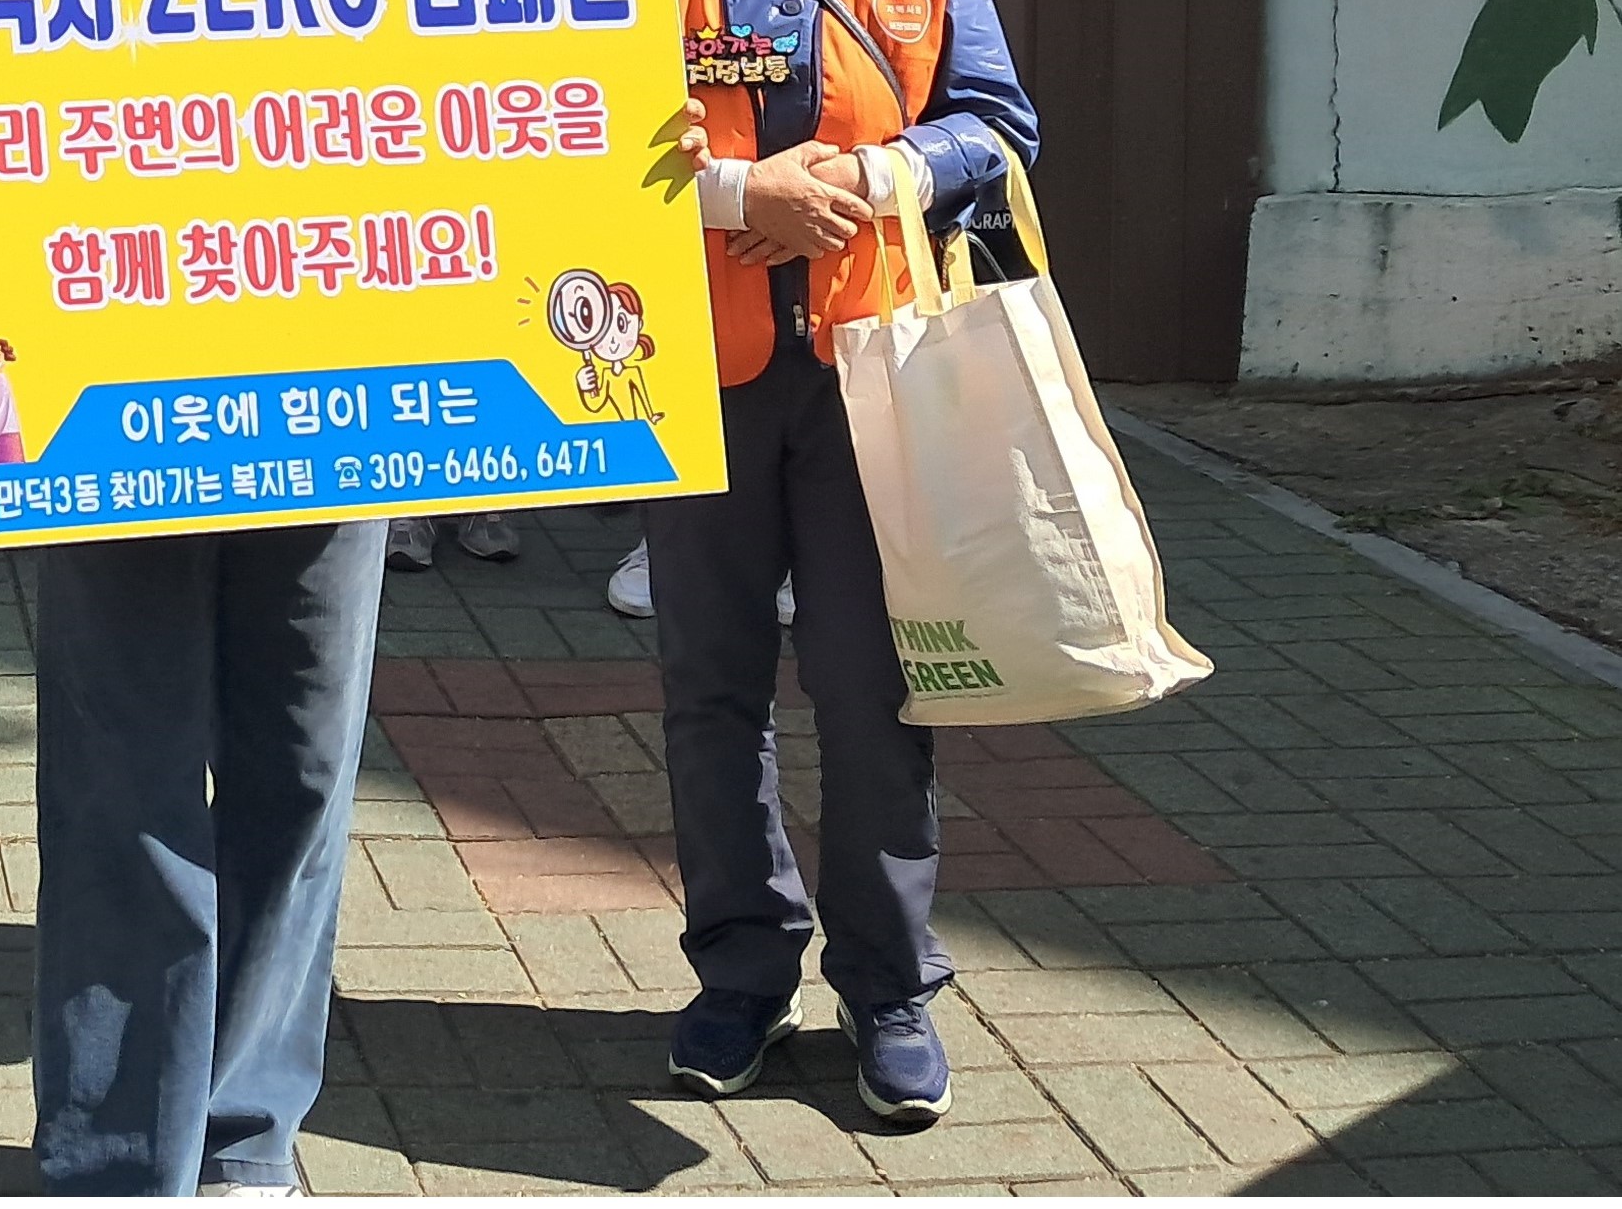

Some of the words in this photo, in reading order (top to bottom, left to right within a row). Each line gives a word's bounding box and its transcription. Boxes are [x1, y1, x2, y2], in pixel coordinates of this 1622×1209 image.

[687, 55, 791, 85] 지정보통
[64, 92, 235, 178] 주변의
[254, 85, 423, 170] 어려운
[443, 80, 608, 159] 이웃을
[49, 228, 166, 305] 함께
[182, 210, 496, 296] 찾아주세요!
[120, 392, 261, 445] 이웃에
[282, 384, 370, 438] 힘이
[392, 378, 479, 430] 되는
[109, 461, 223, 509] 찾아가는
[231, 455, 316, 502] 복지팀
[368, 445, 528, 489] 309-6466,
[537, 437, 608, 479] 6471
[891, 618, 980, 654] THINK
[903, 658, 1005, 693] GREEN
